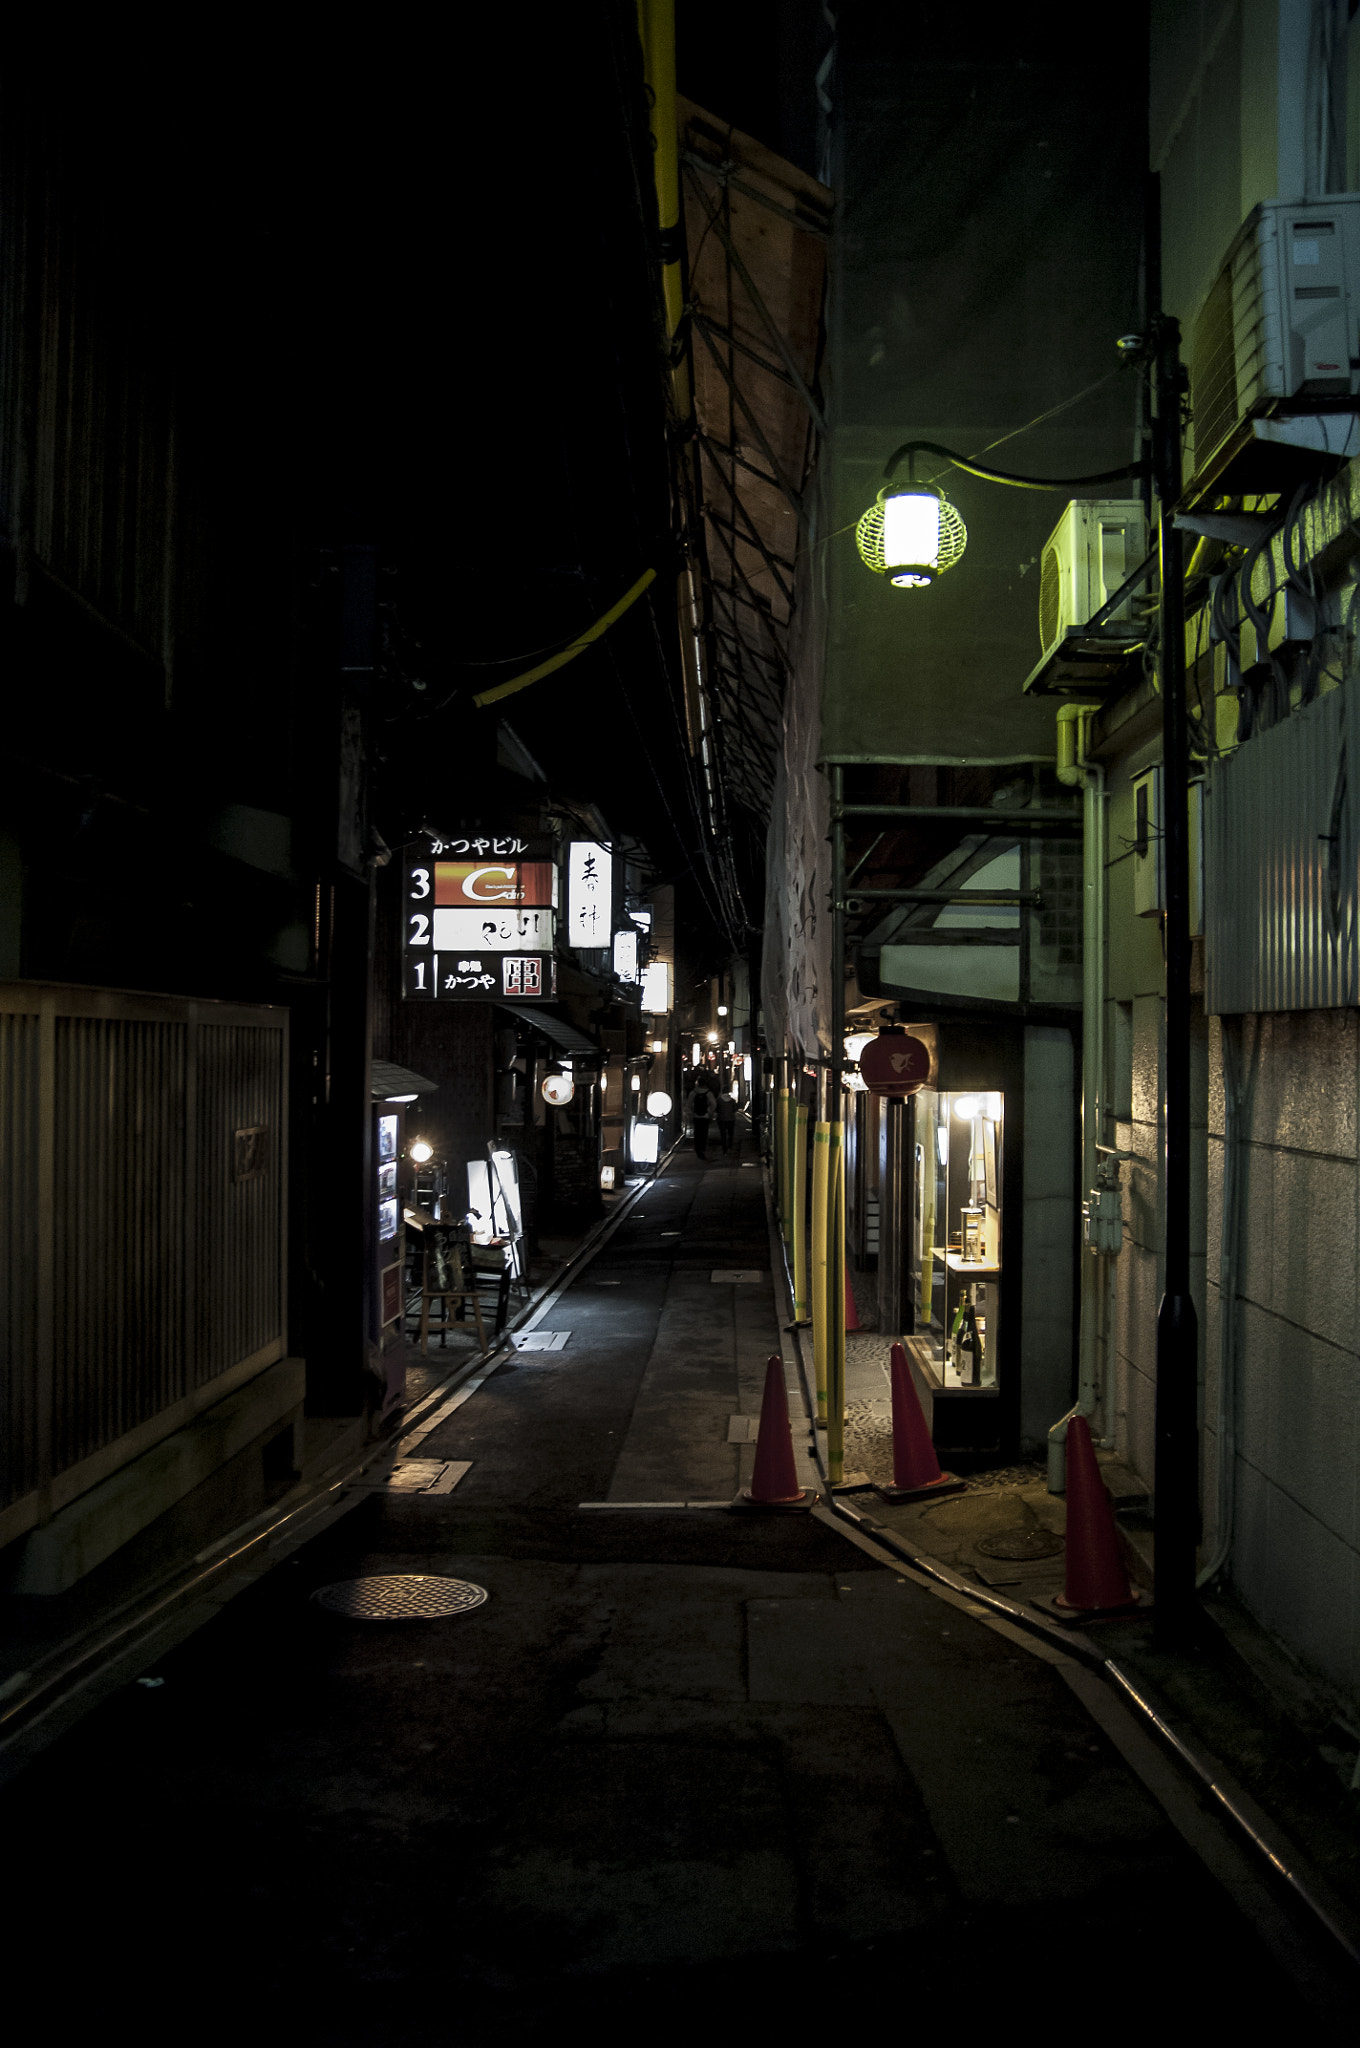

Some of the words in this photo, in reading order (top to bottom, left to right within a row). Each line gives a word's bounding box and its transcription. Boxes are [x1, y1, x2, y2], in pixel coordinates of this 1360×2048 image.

[430, 836, 529, 856] かつやビル
[410, 868, 431, 899] 3
[409, 914, 431, 945] 2
[413, 962, 428, 990] 1
[444, 973, 497, 990] かつや
